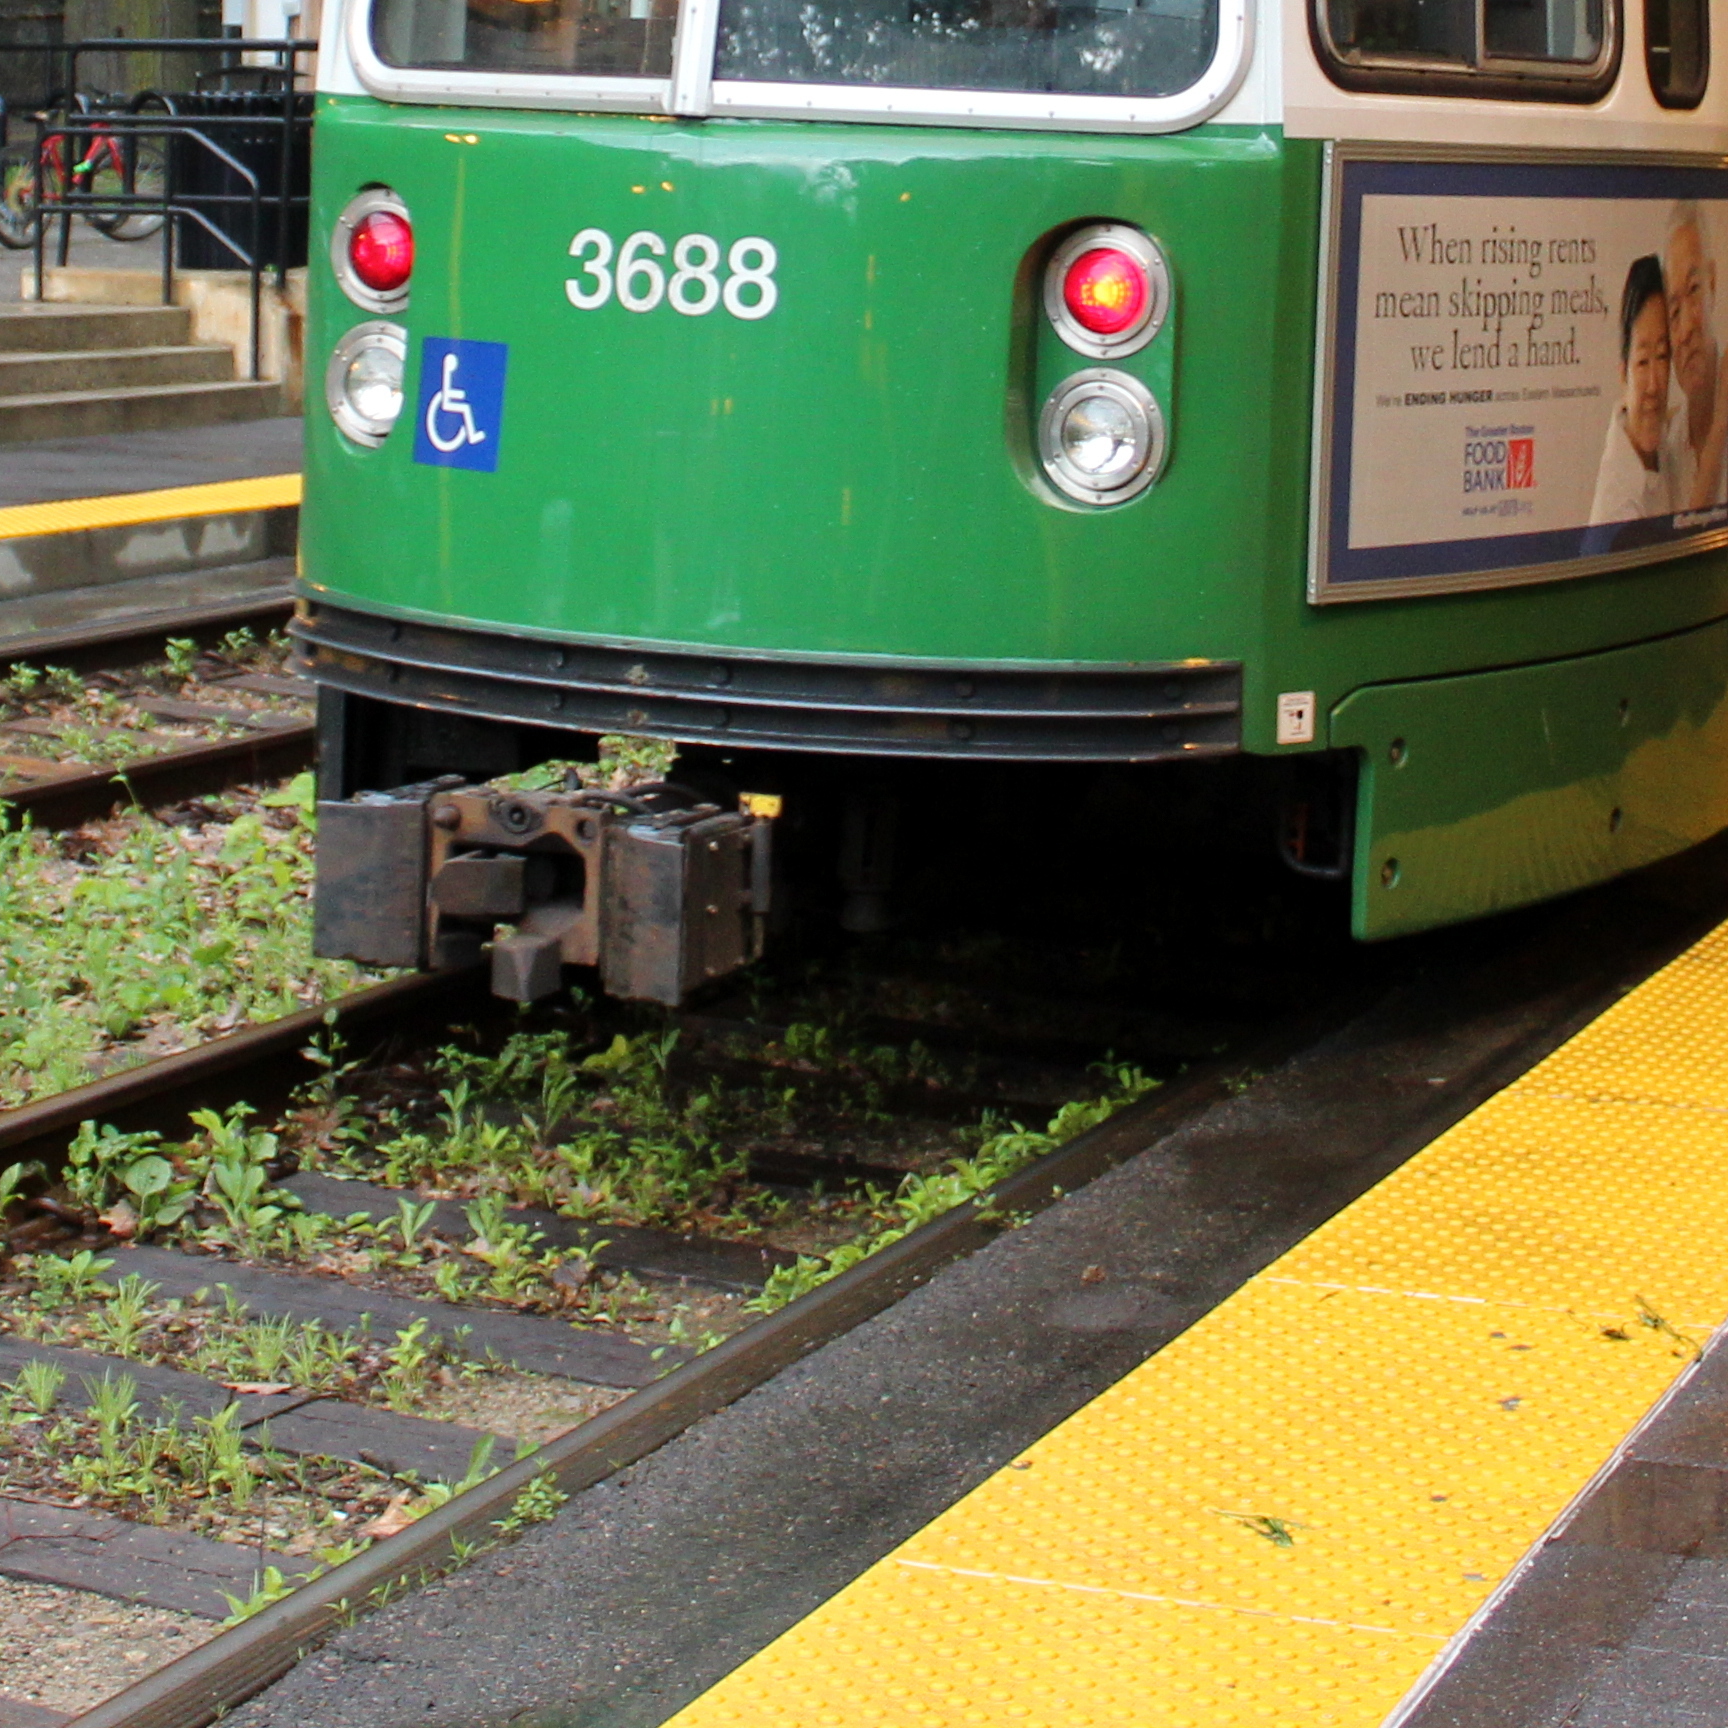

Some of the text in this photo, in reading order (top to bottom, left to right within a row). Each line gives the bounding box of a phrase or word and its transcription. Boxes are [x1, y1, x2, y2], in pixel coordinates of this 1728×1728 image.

[1398, 223, 1596, 278] When rising rents
[565, 227, 778, 320] 3688
[1374, 274, 1609, 332] mean skipping meals,
[1411, 327, 1581, 371] we lend a hand.
[1404, 391, 1446, 406] ENDING
[1449, 389, 1493, 404] HUNGER
[1464, 441, 1507, 466] FOOD
[1463, 469, 1506, 493] BANK
